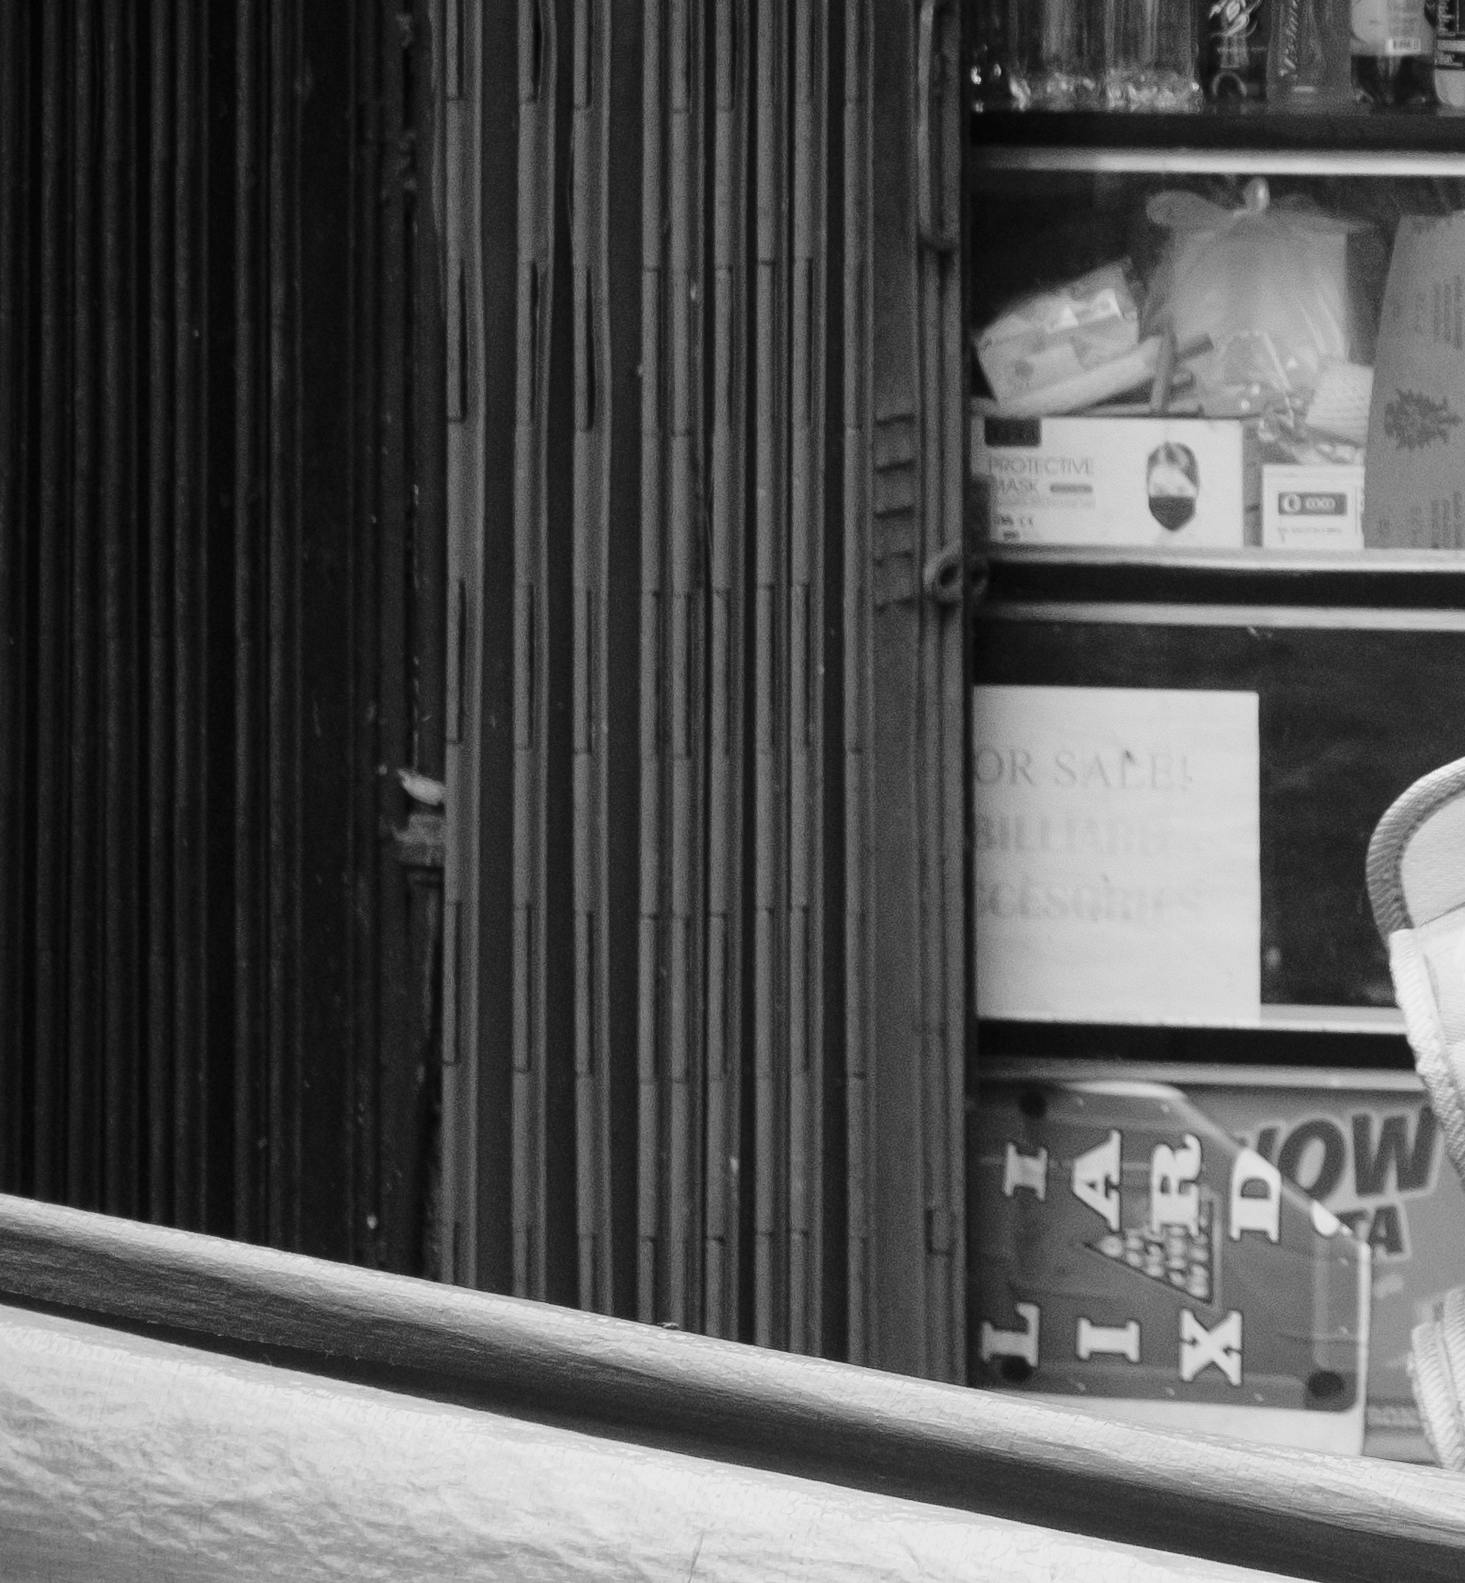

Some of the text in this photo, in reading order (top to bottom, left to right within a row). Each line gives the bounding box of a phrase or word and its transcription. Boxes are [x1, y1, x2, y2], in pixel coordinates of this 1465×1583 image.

[988, 457, 1095, 475] PROTECTIVE
[975, 747, 1194, 791] OR SALE!
